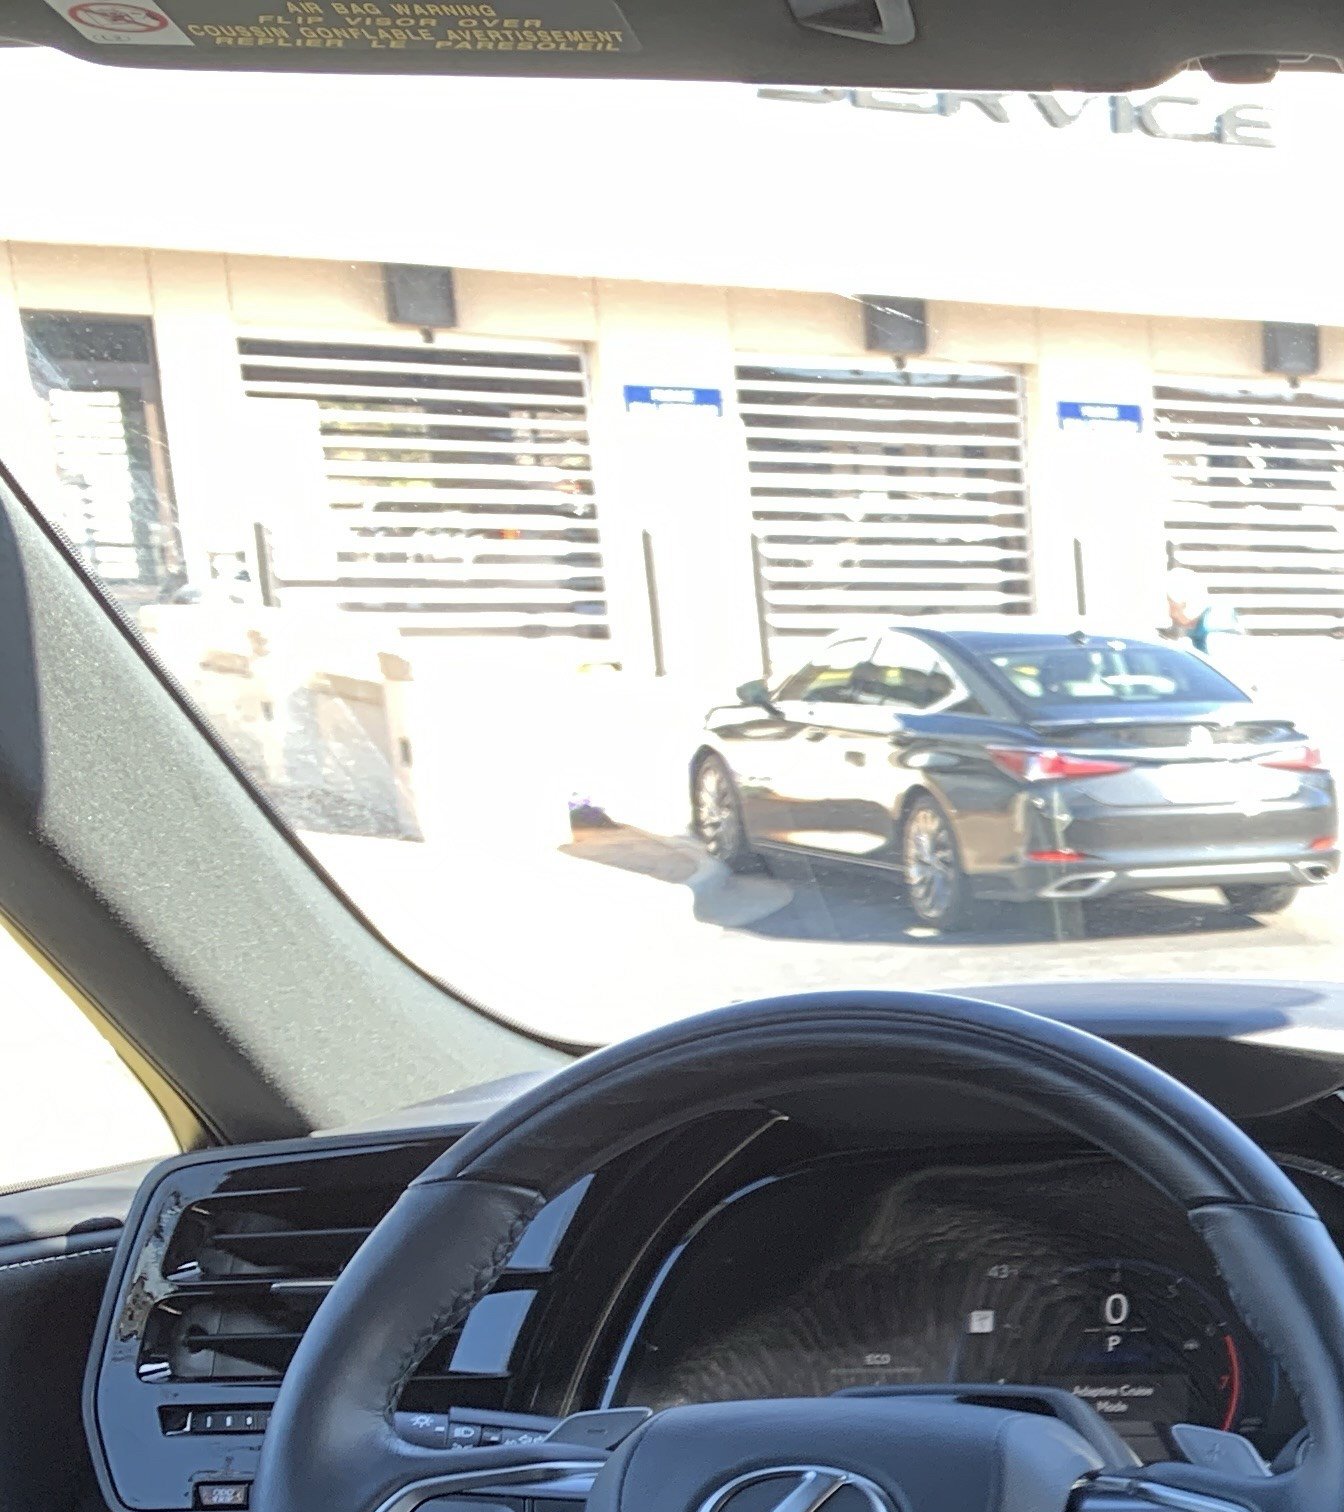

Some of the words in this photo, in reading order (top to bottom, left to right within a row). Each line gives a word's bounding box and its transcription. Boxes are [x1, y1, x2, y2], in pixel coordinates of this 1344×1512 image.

[286, 1, 324, 14] AIR
[331, 2, 382, 15] BAG
[389, 3, 497, 17] WARNING
[258, 15, 324, 25] FLIP
[345, 16, 437, 26] VISOR
[458, 18, 542, 28] OVER
[187, 24, 289, 38] COUSSIN
[299, 26, 435, 41] GONFLABLE
[447, 29, 624, 43] AVERTISSEMENT
[215, 36, 344, 48] REPLIER
[370, 39, 406, 49] LE
[435, 40, 620, 51] PARESOLEIL
[1104, 1292, 1130, 1325] 0
[1106, 1334, 1123, 1352] P
[864, 1353, 891, 1366] ECO
[1096, 1400, 1129, 1414] Mode
